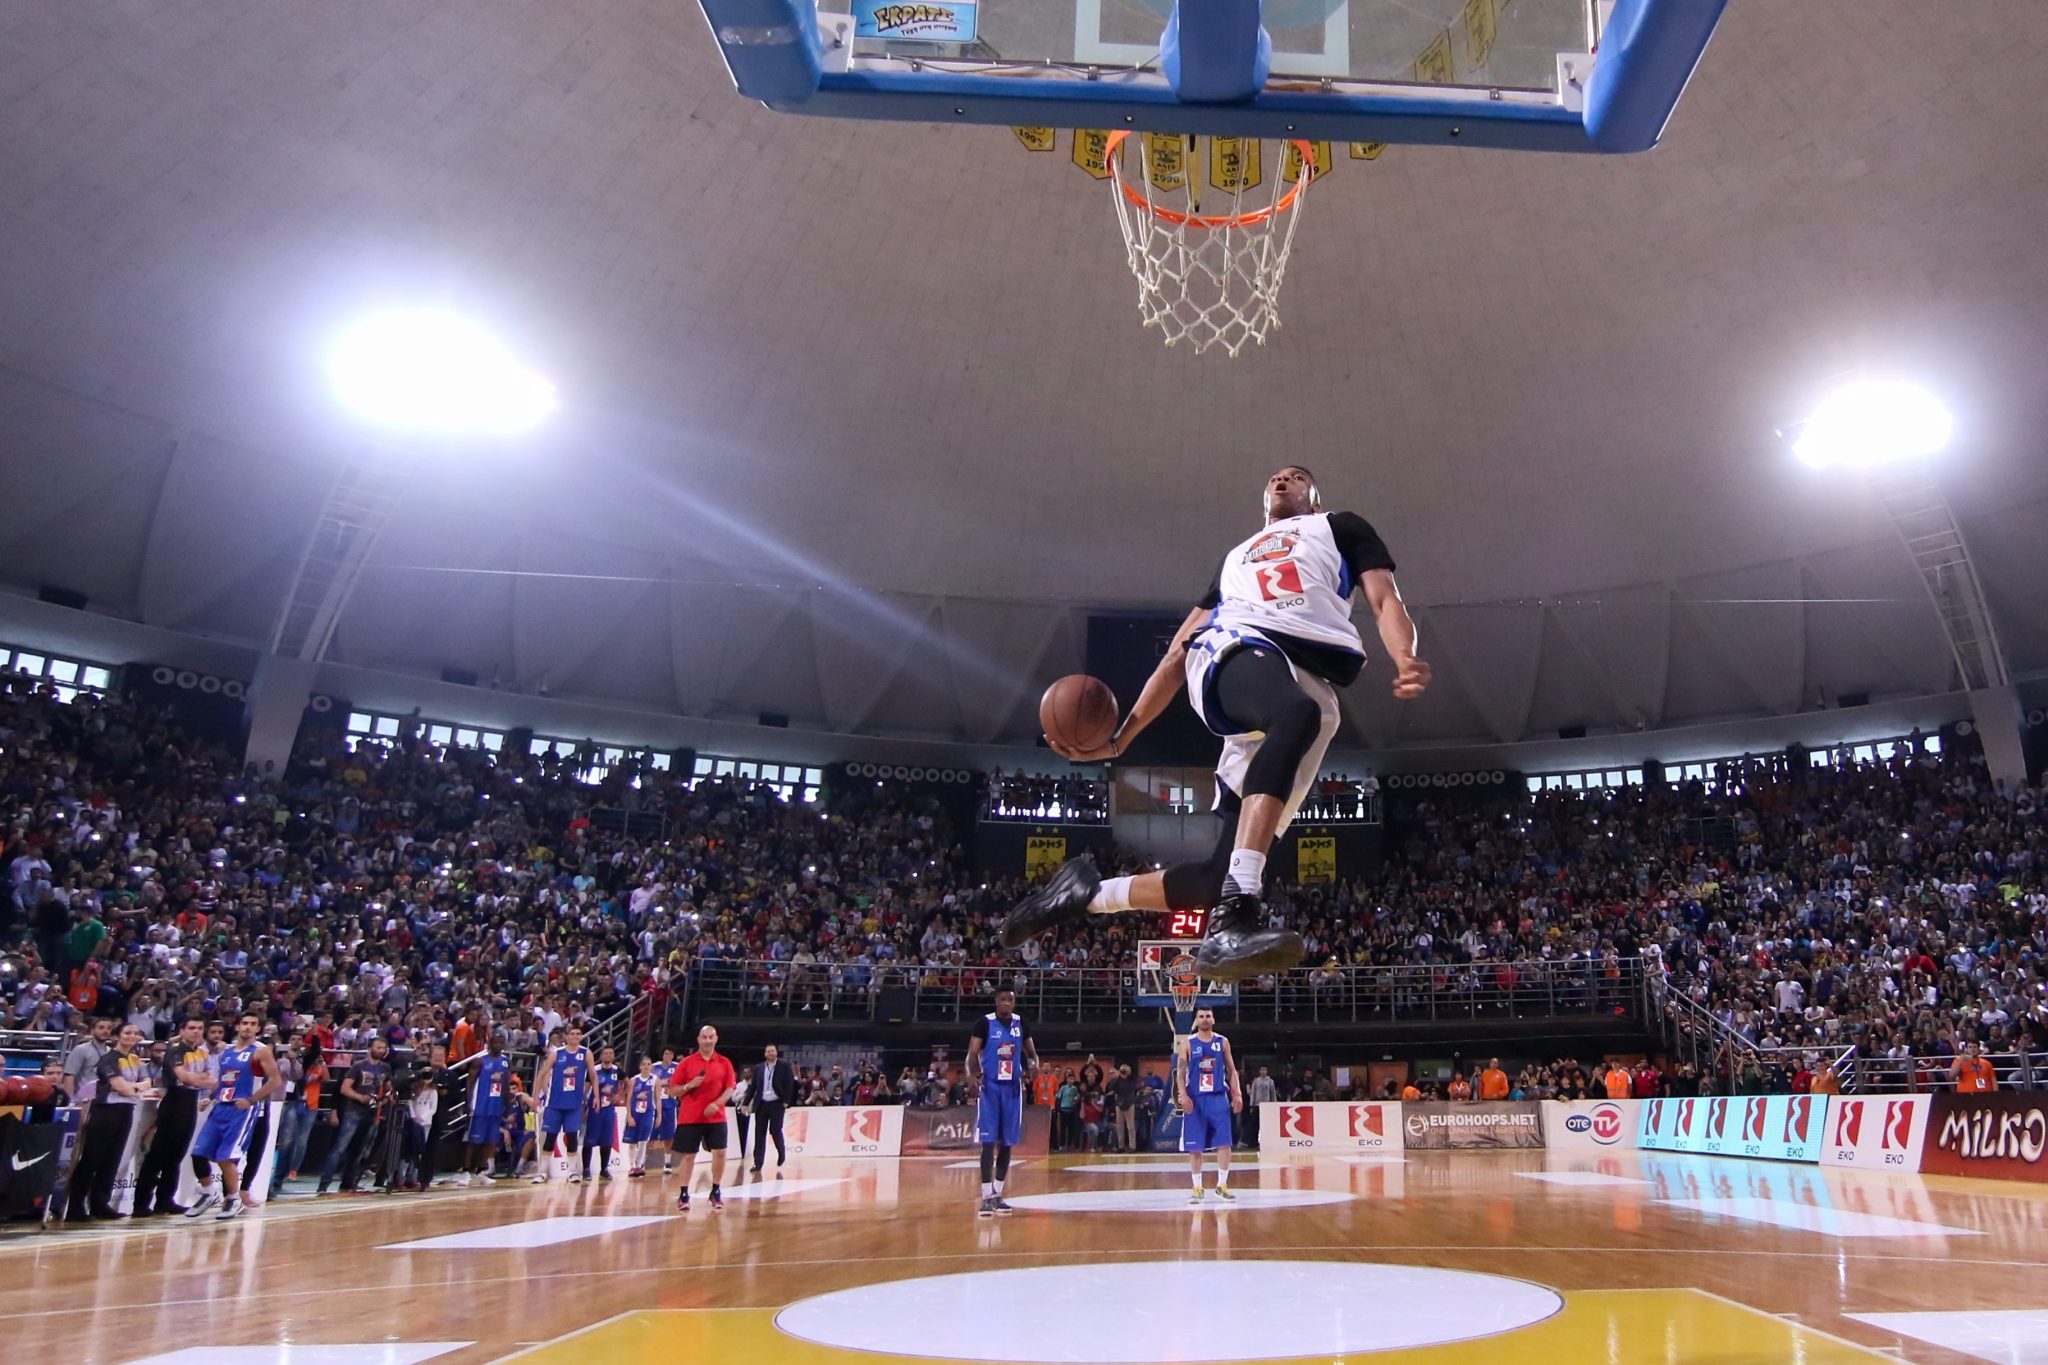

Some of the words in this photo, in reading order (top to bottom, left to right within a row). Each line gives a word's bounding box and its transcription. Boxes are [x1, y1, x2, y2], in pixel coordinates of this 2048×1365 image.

[1276, 598, 1305, 610] EKO
[1171, 914, 1202, 934] 24
[1010, 1027, 1021, 1037] 43
[1211, 1042, 1221, 1052] 43
[236, 1051, 251, 1062] 43
[1429, 1114, 1536, 1127] EUROHOOPS.NET
[1593, 1116, 1620, 1131] TV
[852, 1144, 878, 1152] EKO
[1646, 1139, 1656, 1147] EKO
[1675, 1140, 1687, 1149] EKO
[1707, 1142, 1721, 1151] EKO
[1745, 1144, 1761, 1155] EKO
[1786, 1147, 1804, 1158] EKO
[1837, 1150, 1855, 1161] EKO
[1884, 1154, 1904, 1165] EKO
[608, 1157, 621, 1167] KO
